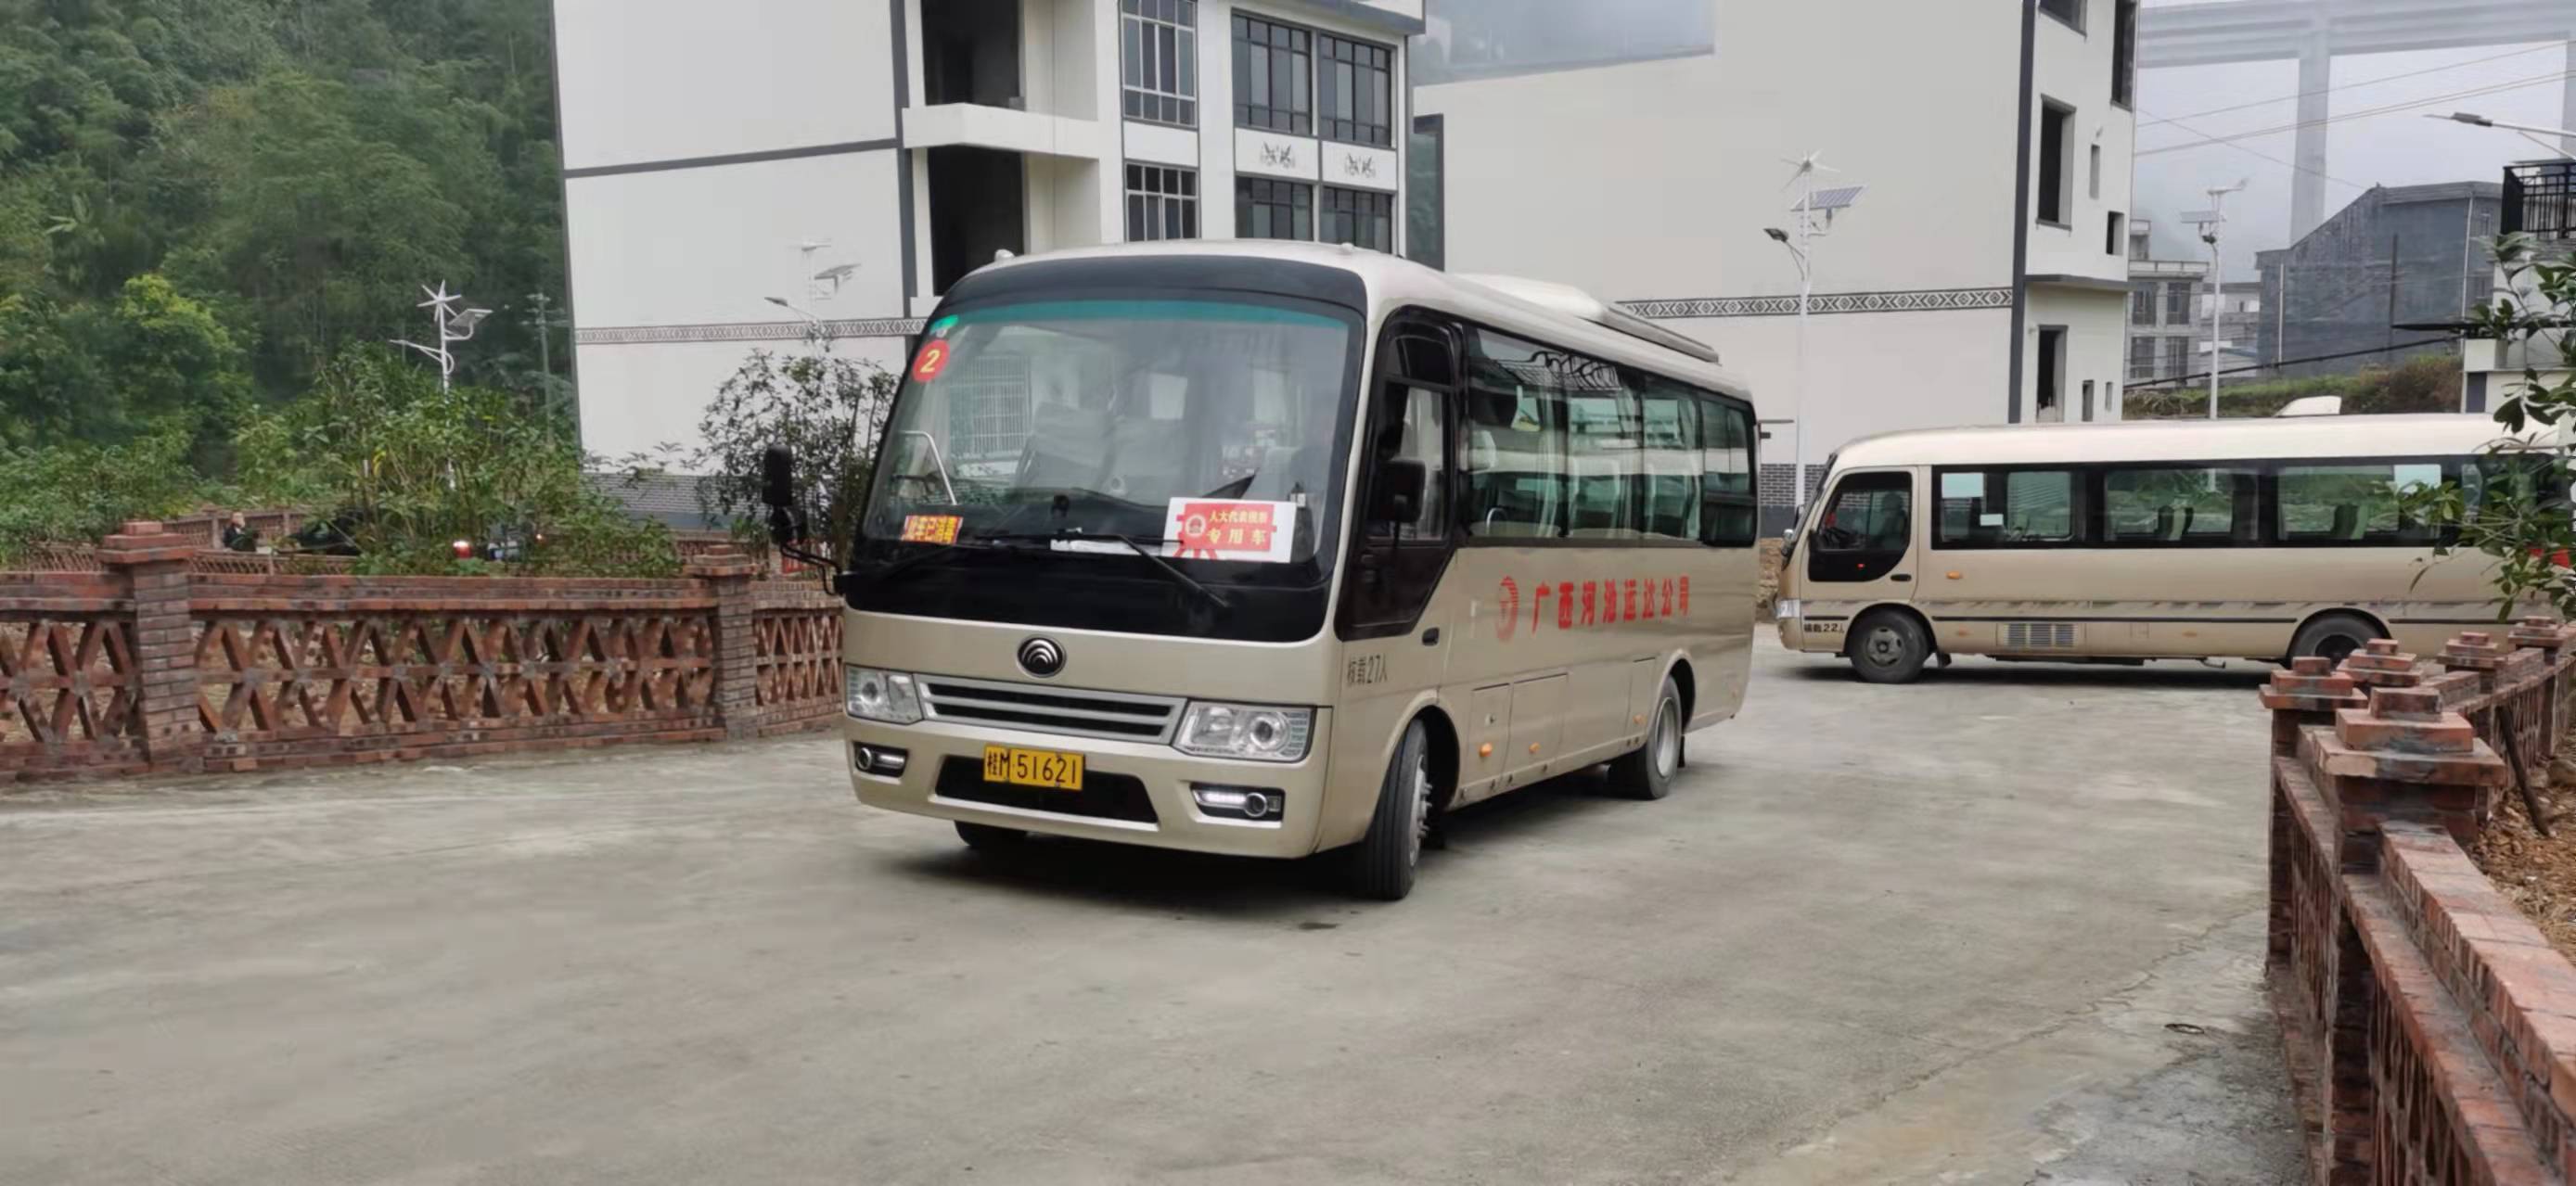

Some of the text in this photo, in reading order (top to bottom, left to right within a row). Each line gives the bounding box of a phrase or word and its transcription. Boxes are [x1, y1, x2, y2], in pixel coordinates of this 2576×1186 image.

[920, 349, 941, 373] 2
[1208, 528, 1266, 544] 专用车
[1532, 576, 1689, 634] 广西河池运达公司
